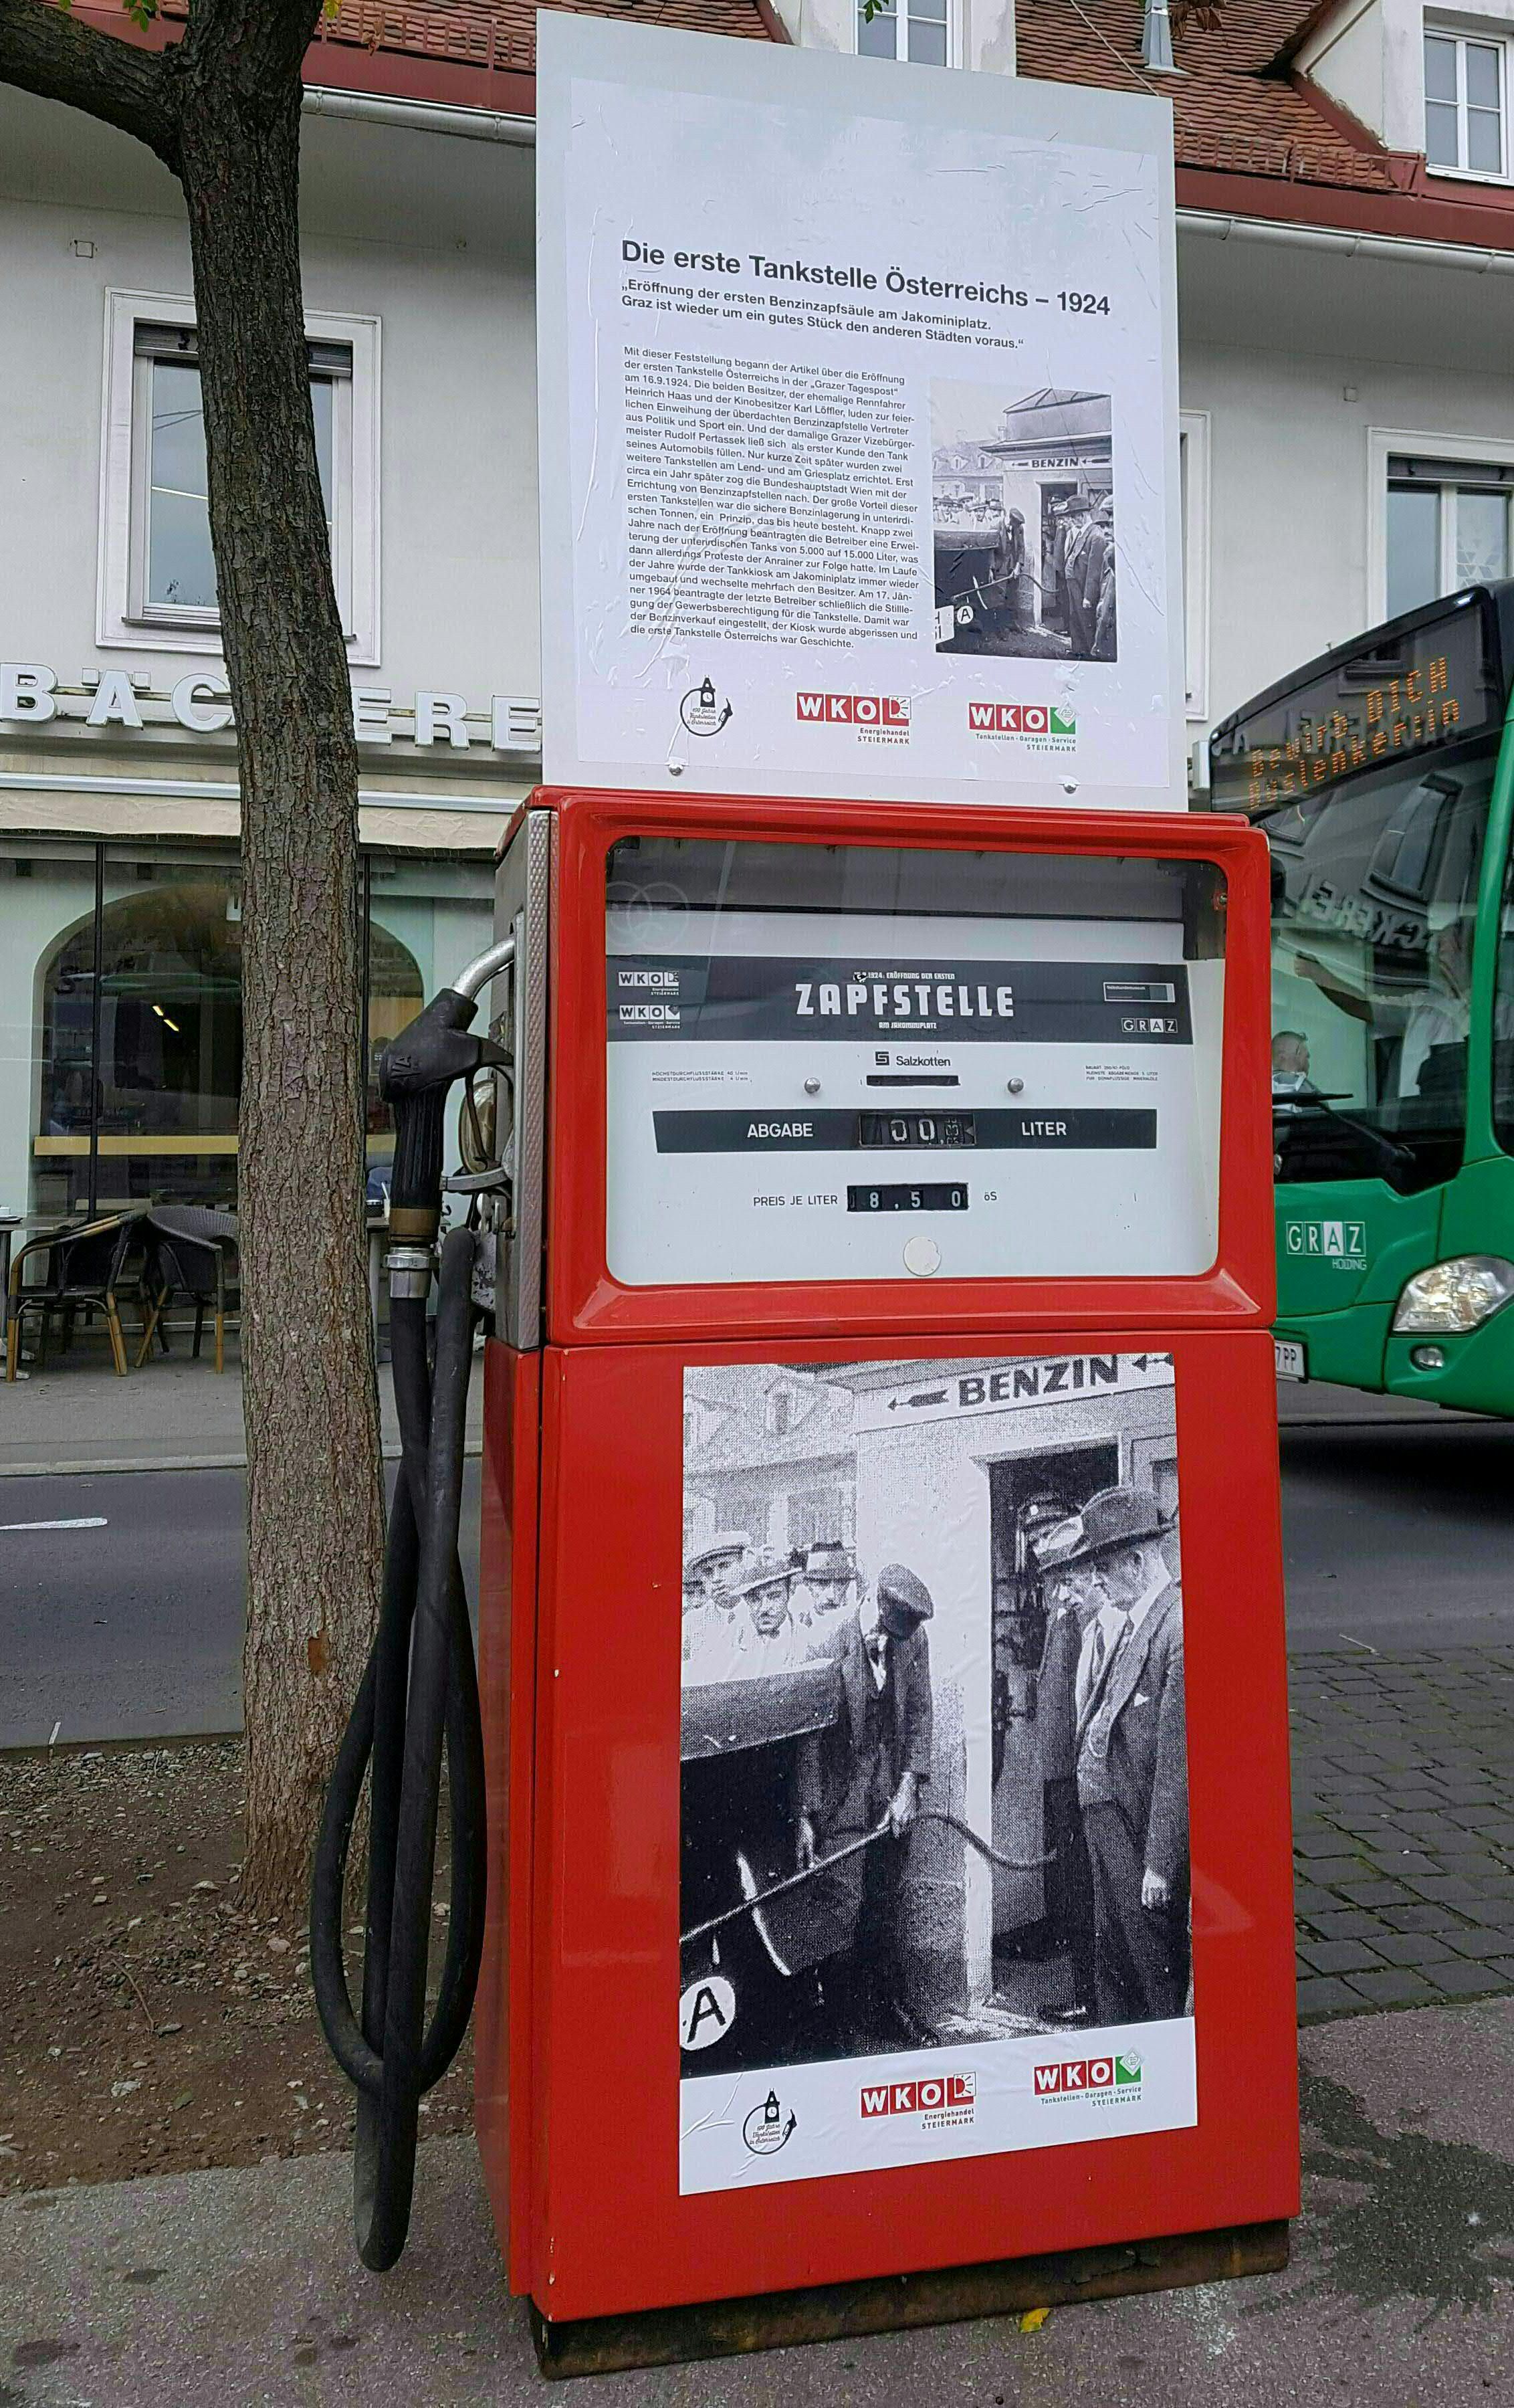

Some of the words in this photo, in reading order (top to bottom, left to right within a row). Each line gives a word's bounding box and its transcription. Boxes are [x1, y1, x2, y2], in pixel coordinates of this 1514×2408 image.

[622, 239, 665, 265] Die
[673, 251, 740, 274] erste
[748, 254, 877, 290] Tankstelle
[885, 267, 1028, 306] Österreichs
[1057, 291, 1110, 315] 1924
[621, 278, 693, 299] „Eröffnung
[697, 287, 720, 300] der
[723, 292, 765, 305] ersten
[769, 295, 874, 317] Benzinzapfsäule
[878, 310, 897, 320] am
[901, 310, 991, 330] Jakominiplatz.
[621, 295, 653, 308] Graz
[656, 298, 672, 310] ist
[675, 302, 719, 316] wieder
[722, 308, 742, 318] um
[746, 309, 764, 321] ein
[768, 313, 803, 325] gutes
[806, 315, 843, 330] Stück
[846, 320, 869, 332] den
[872, 324, 922, 338] anderen
[925, 328, 972, 344] Städten
[974, 336, 1023, 348] voraus.“
[624, 345, 639, 356] Mit
[641, 347, 671, 359] dieser
[674, 350, 732, 368] Feststellung
[734, 357, 769, 370] begann
[771, 361, 788, 372] der
[789, 363, 819, 375] Artikel
[821, 367, 843, 377] über
[844, 369, 859, 379] die
[861, 371, 905, 386] Eröffnung
[624, 373, 639, 382] am
[642, 373, 691, 387] 16.9.1924.
[693, 378, 710, 389] Die
[712, 380, 745, 393] beiden
[747, 384, 786, 398] Besitzer,
[788, 389, 805, 399] der
[806, 391, 854, 405] ehemalige
[855, 396, 905, 409] Rennfahrer
[625, 398, 654, 410] lichen
[656, 401, 712, 417] Einweihung
[714, 407, 731, 417] der
[732, 409, 790, 423] überdachten
[793, 415, 868, 431] Benzinzapfstelle
[869, 423, 909, 435] Vertreter
[625, 426, 662, 437] meister
[664, 428, 696, 439] Rudolf
[698, 431, 746, 445] Pertassek
[748, 436, 764, 446] ließ
[766, 438, 786, 449] sich
[790, 441, 804, 450] als
[806, 443, 834, 454] erster
[835, 445, 865, 456] Kunde
[867, 448, 885, 458] den
[886, 450, 908, 460] Tank
[626, 452, 661, 463] weitere
[663, 454, 718, 468] Tankstellen
[720, 462, 734, 470] am
[737, 462, 765, 472] Lend-
[767, 466, 785, 475] und
[787, 468, 802, 476] am
[804, 468, 851, 482] Griesplatz
[852, 474, 893, 484] errichtet.
[895, 476, 913, 486] Erst
[1031, 458, 1079, 468] BENZIN
[627, 478, 677, 493] Errichtung
[679, 484, 697, 493] von
[699, 484, 782, 500] Benzinzapfstellen
[784, 493, 810, 503] nach.
[812, 494, 829, 504] Der
[830, 497, 857, 507] große
[859, 498, 887, 510] Vorteil
[889, 501, 918, 512] dieser
[627, 504, 657, 515] schen
[658, 506, 698, 520] Tonnen,
[699, 510, 714, 520] ein
[719, 512, 754, 526] Prinzip,
[756, 515, 774, 525] das
[776, 516, 790, 527] bis
[792, 518, 819, 529] heute
[821, 520, 858, 532] besteht.
[860, 524, 891, 538] Knapp
[892, 528, 913, 537] zwei
[629, 557, 645, 568] der
[647, 559, 675, 570] Jahre
[677, 562, 706, 572] wurde
[708, 563, 725, 573] der
[726, 565, 773, 577] Tankkiosk
[775, 571, 790, 579] am
[792, 570, 856, 585] Jakominiplatz
[858, 575, 887, 586] immer
[888, 578, 920, 588] wieder
[960, 608, 971, 621] A
[629, 623, 645, 633] die
[647, 625, 672, 635] erste
[673, 625, 722, 638] Tankstelle
[724, 627, 778, 641] Österreichs
[780, 635, 798, 643] war
[799, 634, 854, 647] Geschichte.
[1367, 656, 1448, 724] DICH
[798, 694, 877, 720] WKO
[970, 706, 1045, 730] WKO
[857, 736, 910, 744] STEIERMARK
[859, 727, 910, 736] Energiehandel
[976, 733, 1014, 741] Tankstellen
[619, 973, 662, 985] WKO
[620, 1007, 663, 1019] WKO
[795, 983, 1014, 1017] ZAPFSTELLE
[1123, 1019, 1176, 1031] GRAZ
[896, 1056, 951, 1067] Salzkotten
[747, 1123, 814, 1138] ABGABE
[1022, 1122, 1067, 1136] LITER
[753, 1196, 785, 1207] PREIS
[790, 1195, 803, 1206] JE
[808, 1195, 838, 1205] LITER
[984, 1191, 998, 1201] öS
[1288, 1225, 1362, 1253] GRAZ
[958, 1354, 1119, 1407] BENZIN
[687, 1987, 726, 2043] A
[1035, 2062, 1110, 2090] WKO
[863, 2084, 942, 2113] WKO
[1041, 2094, 1081, 2105] Tankstellen
[1085, 2090, 1113, 2101] Garagen
[1116, 2086, 1142, 2095] Service
[1091, 2094, 1142, 2108] STEIERMARK
[921, 2117, 974, 2130] STEIERMARK
[924, 2108, 974, 2120] Energiehandel
